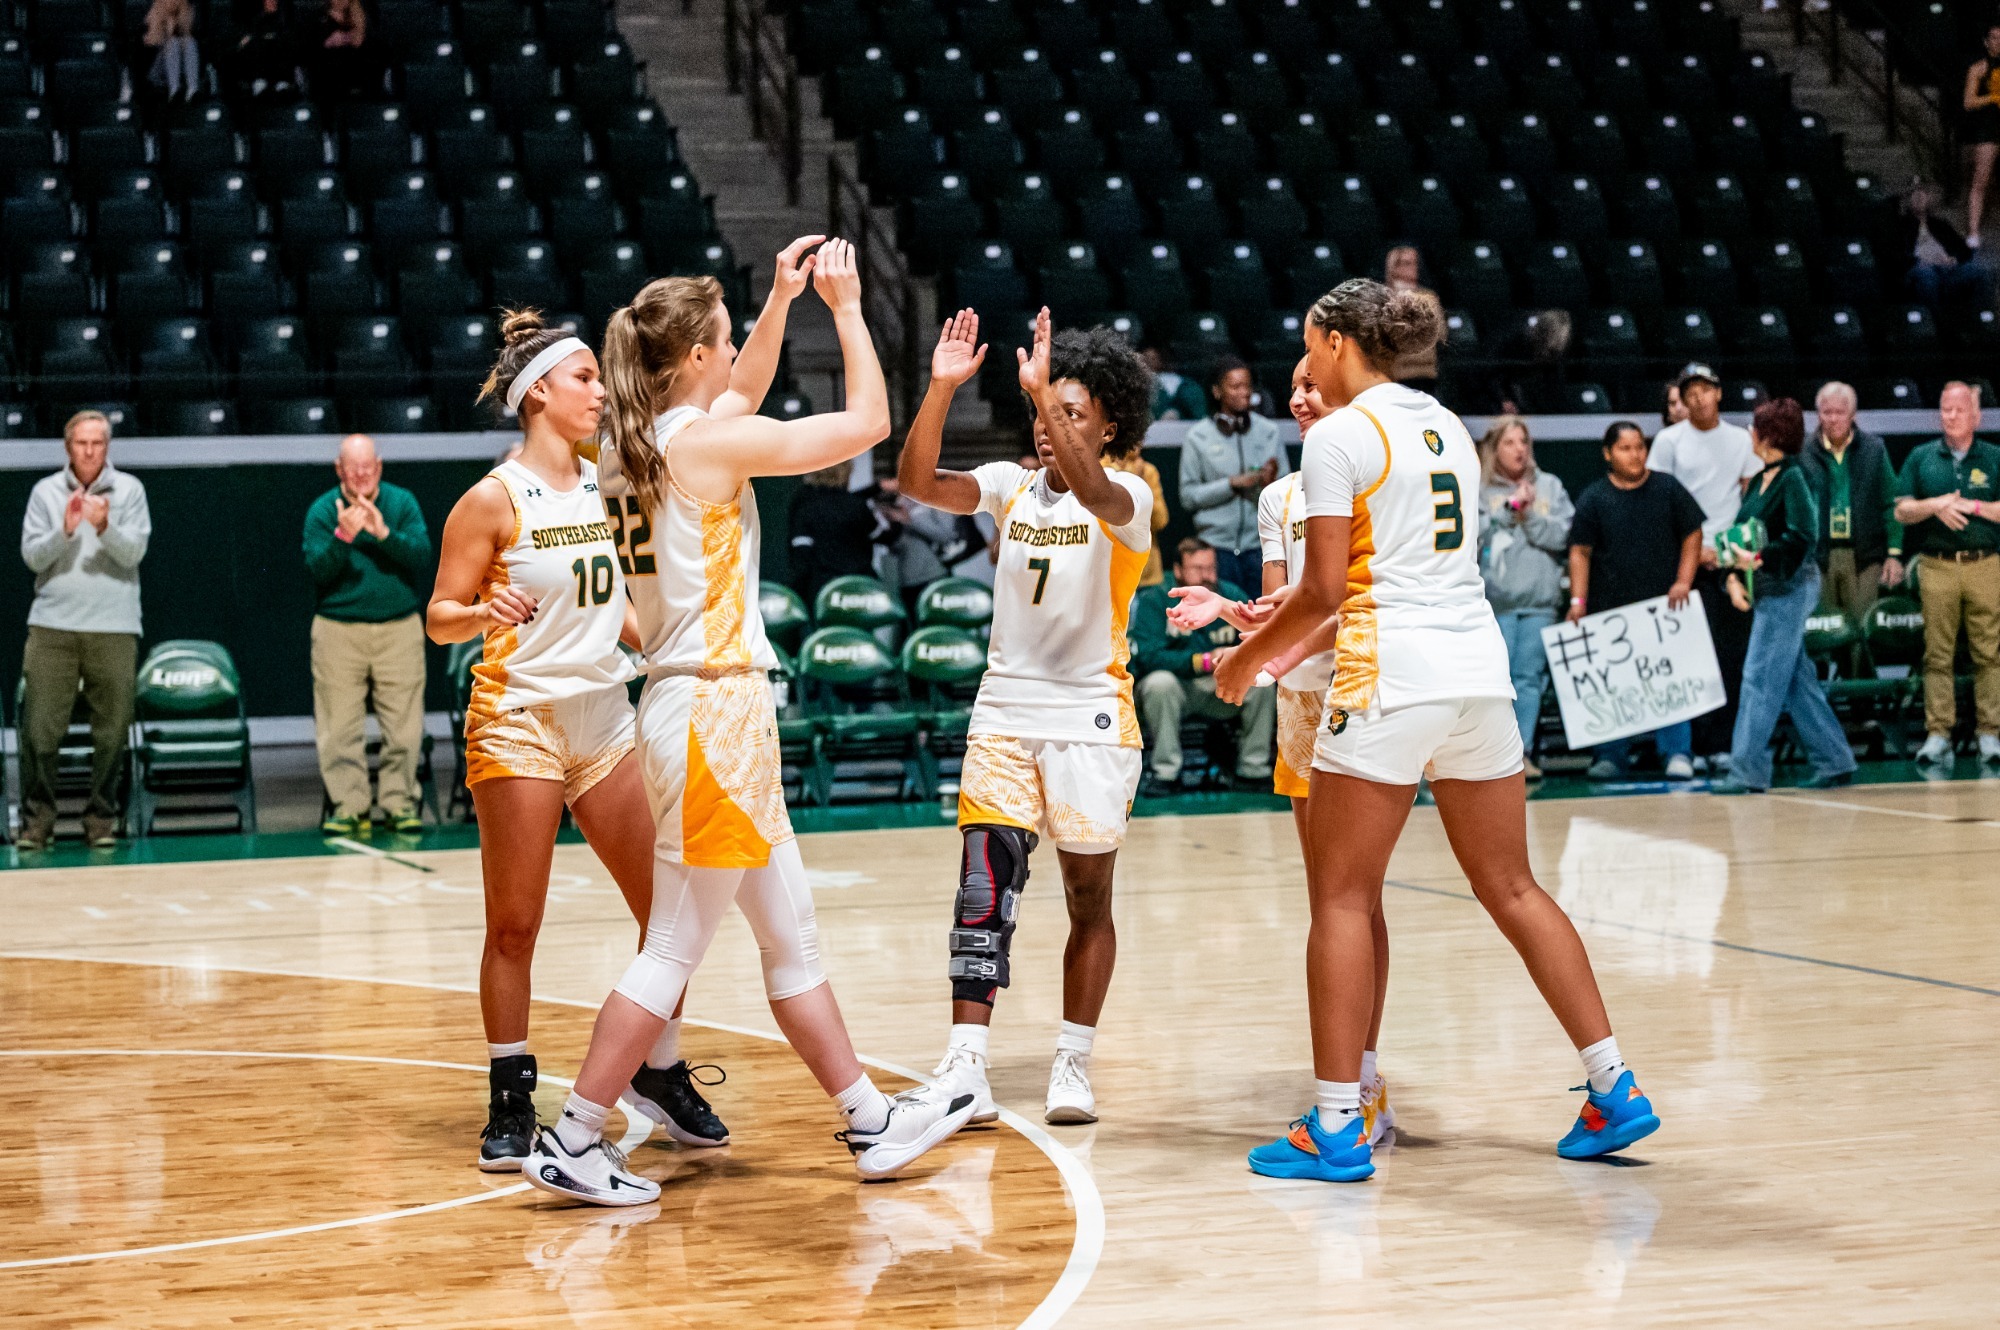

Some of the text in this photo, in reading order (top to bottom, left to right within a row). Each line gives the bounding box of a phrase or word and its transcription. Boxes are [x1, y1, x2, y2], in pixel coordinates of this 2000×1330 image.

[531, 521, 613, 550] SOUTHEASTE
[605, 495, 658, 576] 22
[1430, 471, 1463, 552] 3
[572, 554, 614, 608] 10
[1027, 557, 1051, 606] 7
[1549, 606, 1681, 672] #3 is
[1571, 667, 1617, 700] MY
